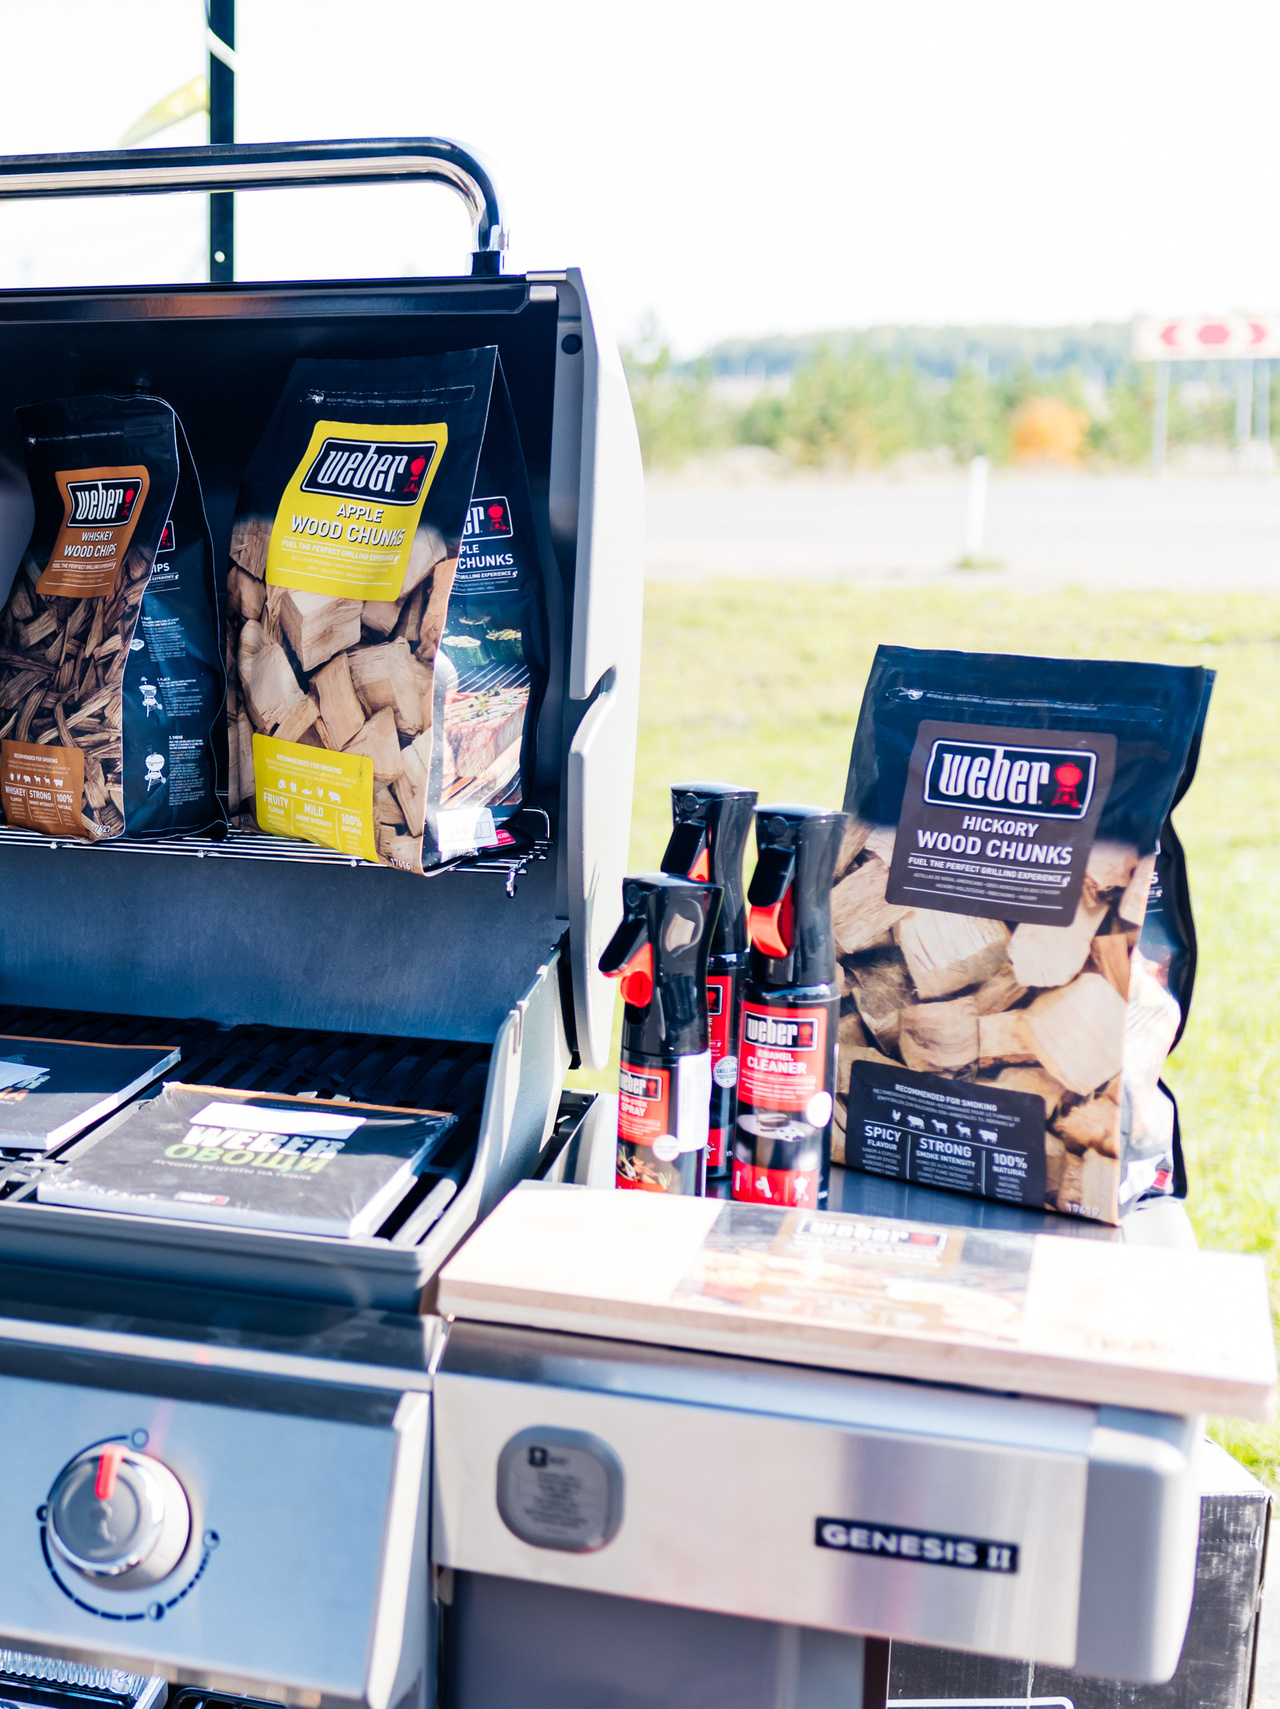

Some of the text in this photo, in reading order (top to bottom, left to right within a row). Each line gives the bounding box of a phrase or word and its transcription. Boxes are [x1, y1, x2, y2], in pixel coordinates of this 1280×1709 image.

[317, 446, 409, 492] weber
[75, 482, 124, 520] weber
[336, 504, 384, 523] APPLE
[82, 531, 114, 542] WHISKEY
[291, 515, 406, 547] WOOD CHUNKS
[64, 543, 118, 558] WOOD CHIPS
[282, 540, 395, 562] FUEL THE PERFECT GRILLING EXPERIENCE
[460, 544, 480, 555] PLE
[458, 554, 514, 569] CHUNKS
[481, 570, 511, 578] EXPERIENCE
[276, 754, 311, 768] RECOMMENDED
[320, 764, 343, 775] SMOKING
[938, 749, 1051, 805] weber
[5, 786, 26, 797] WHISKEY
[29, 790, 52, 801] STRONG
[56, 794, 73, 804] 100%
[263, 792, 289, 808] FRUITY
[268, 806, 284, 815] FLAVOUR
[304, 804, 324, 817] MILD
[296, 814, 332, 828] SMOKE INTENSITY
[341, 814, 363, 828] 100%
[962, 816, 1040, 838] HICKORY
[341, 826, 363, 836] NATURAL
[917, 830, 1073, 865] WOOD CHUNKS
[908, 856, 1063, 883] FUEL THE PERFECT GRILLING EXPERIENCE
[747, 1016, 798, 1046] weber
[758, 1049, 794, 1062] ENAMEL
[746, 1056, 807, 1075] CLEANER
[894, 1084, 998, 1112] RECOMMENDED FOR SMOKING
[621, 1102, 646, 1117] SPRAY
[864, 1125, 902, 1142] SPICY
[182, 1125, 346, 1160] WEBER
[867, 1139, 898, 1151] FLAVOUR
[920, 1138, 972, 1158] STRONG
[164, 1143, 331, 1174] ОВОЩИ
[916, 1150, 976, 1168] SMOKE INTENSITY
[992, 1153, 1028, 1169] 100%
[152, 1159, 313, 1182] ЛУЧШИЕ РЕЦЕПТЫ НА ГРИЛЕ
[992, 1166, 1027, 1178] NATURAL
[821, 1524, 1012, 1569] GENESIS II
